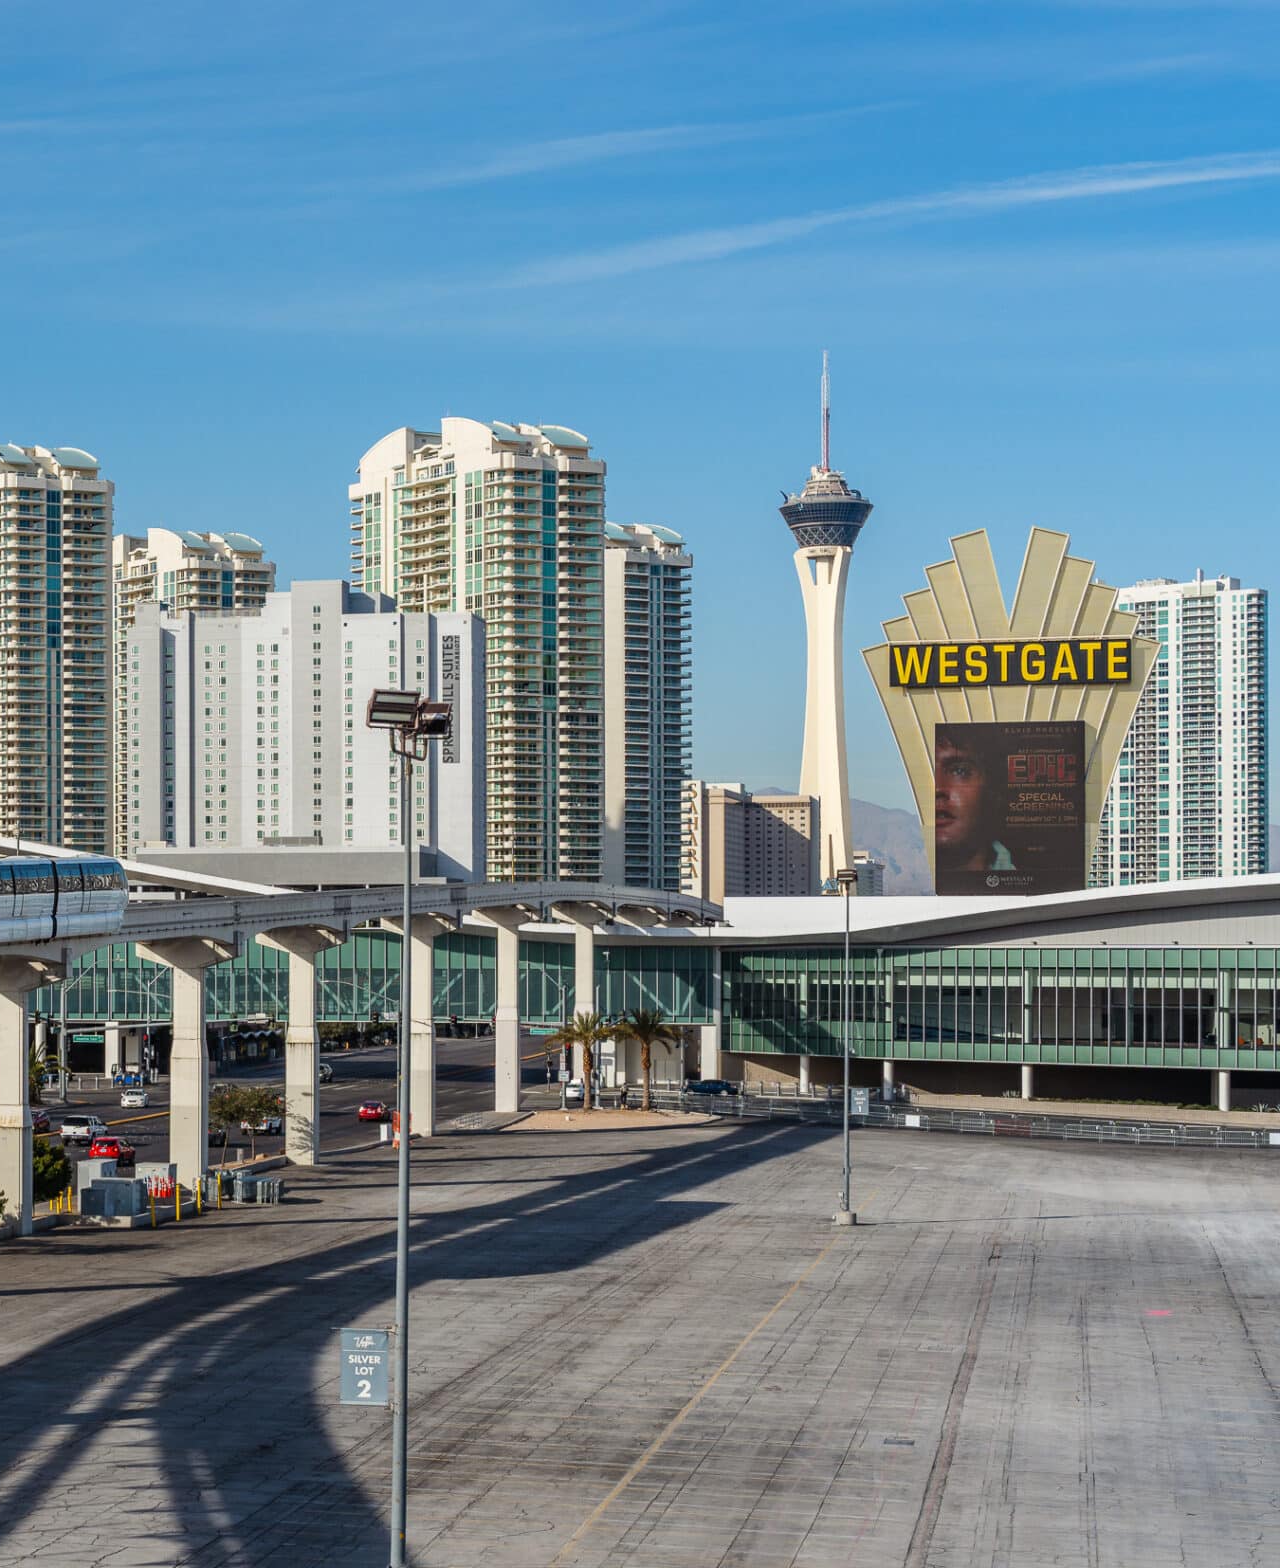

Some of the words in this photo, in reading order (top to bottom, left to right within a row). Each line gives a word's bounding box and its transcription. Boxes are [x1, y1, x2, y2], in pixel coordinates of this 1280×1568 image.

[442, 635, 454, 680] SUITES
[893, 641, 1129, 684] WESTGATE
[442, 683, 454, 763] SPRILL
[1008, 802, 1074, 811] SCREENING
[1018, 792, 1065, 802] SPECIAL
[687, 783, 699, 878] SAHARA
[348, 1354, 381, 1364] SILVER
[355, 1367, 375, 1376] LOT
[357, 1379, 372, 1398] 2
